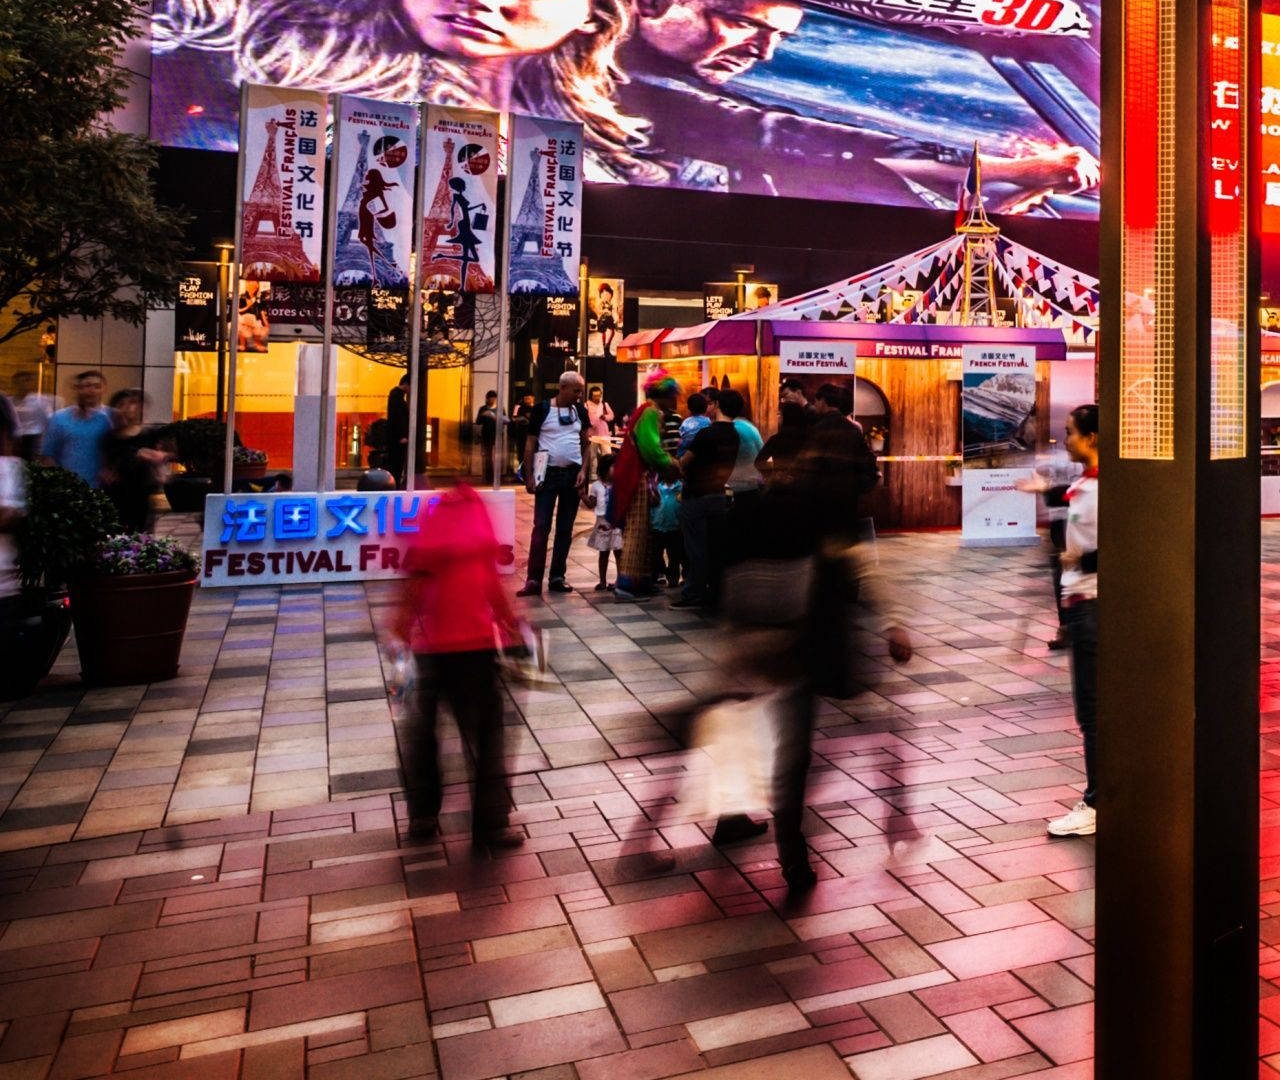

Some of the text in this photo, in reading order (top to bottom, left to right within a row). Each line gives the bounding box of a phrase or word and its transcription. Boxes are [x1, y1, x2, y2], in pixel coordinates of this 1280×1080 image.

[295, 110, 318, 238] 法国文化节
[279, 175, 296, 238] FESTIVAL
[557, 140, 576, 258] 法国文化节
[541, 201, 556, 257] FESTIVAL
[787, 357, 848, 369] FRENCH FESTIVAL
[876, 343, 928, 356] FESTIVAL
[970, 357, 1029, 369] FRENCH FESTIVAL
[220, 495, 443, 544] 法国文化
[204, 548, 352, 578] FESTIVAL
